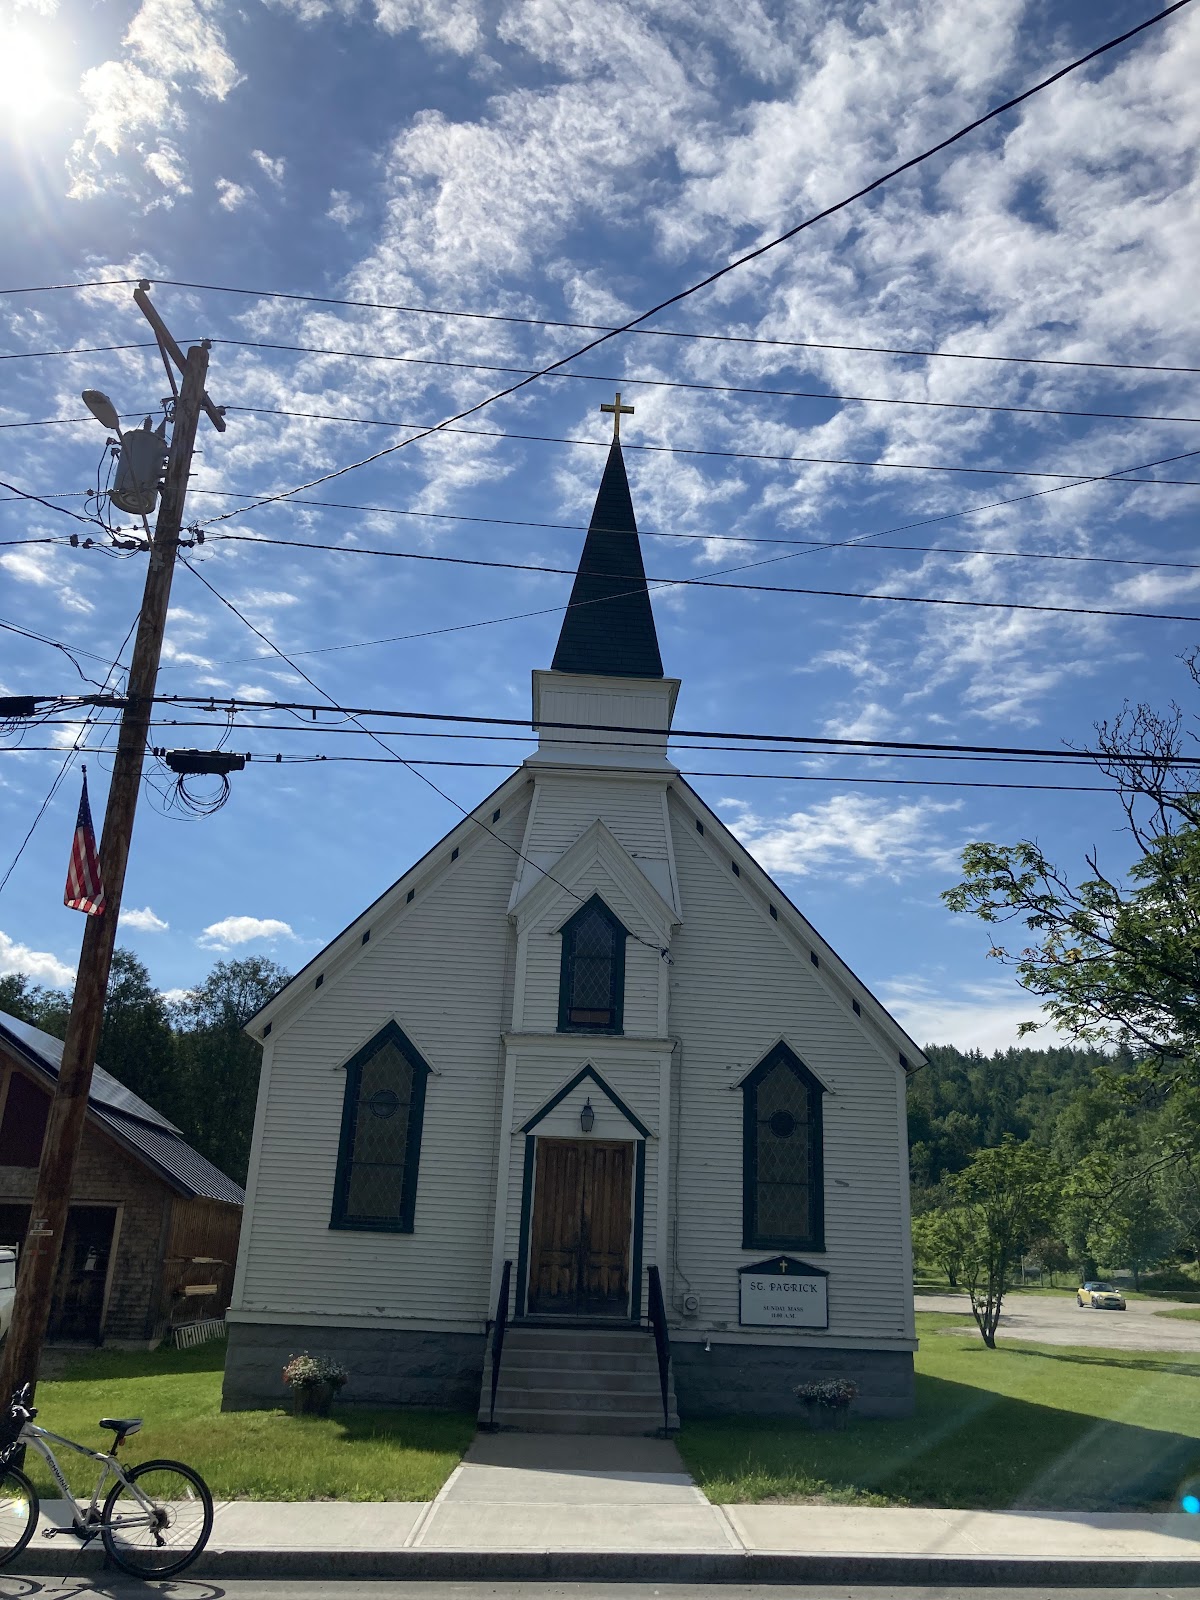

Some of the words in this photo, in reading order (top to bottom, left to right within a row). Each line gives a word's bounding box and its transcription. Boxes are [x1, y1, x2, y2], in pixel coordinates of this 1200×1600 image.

[750, 1281, 765, 1291] ST.
[769, 1282, 818, 1293] PATRICK
[45, 1454, 70, 1491] SCHWINN
